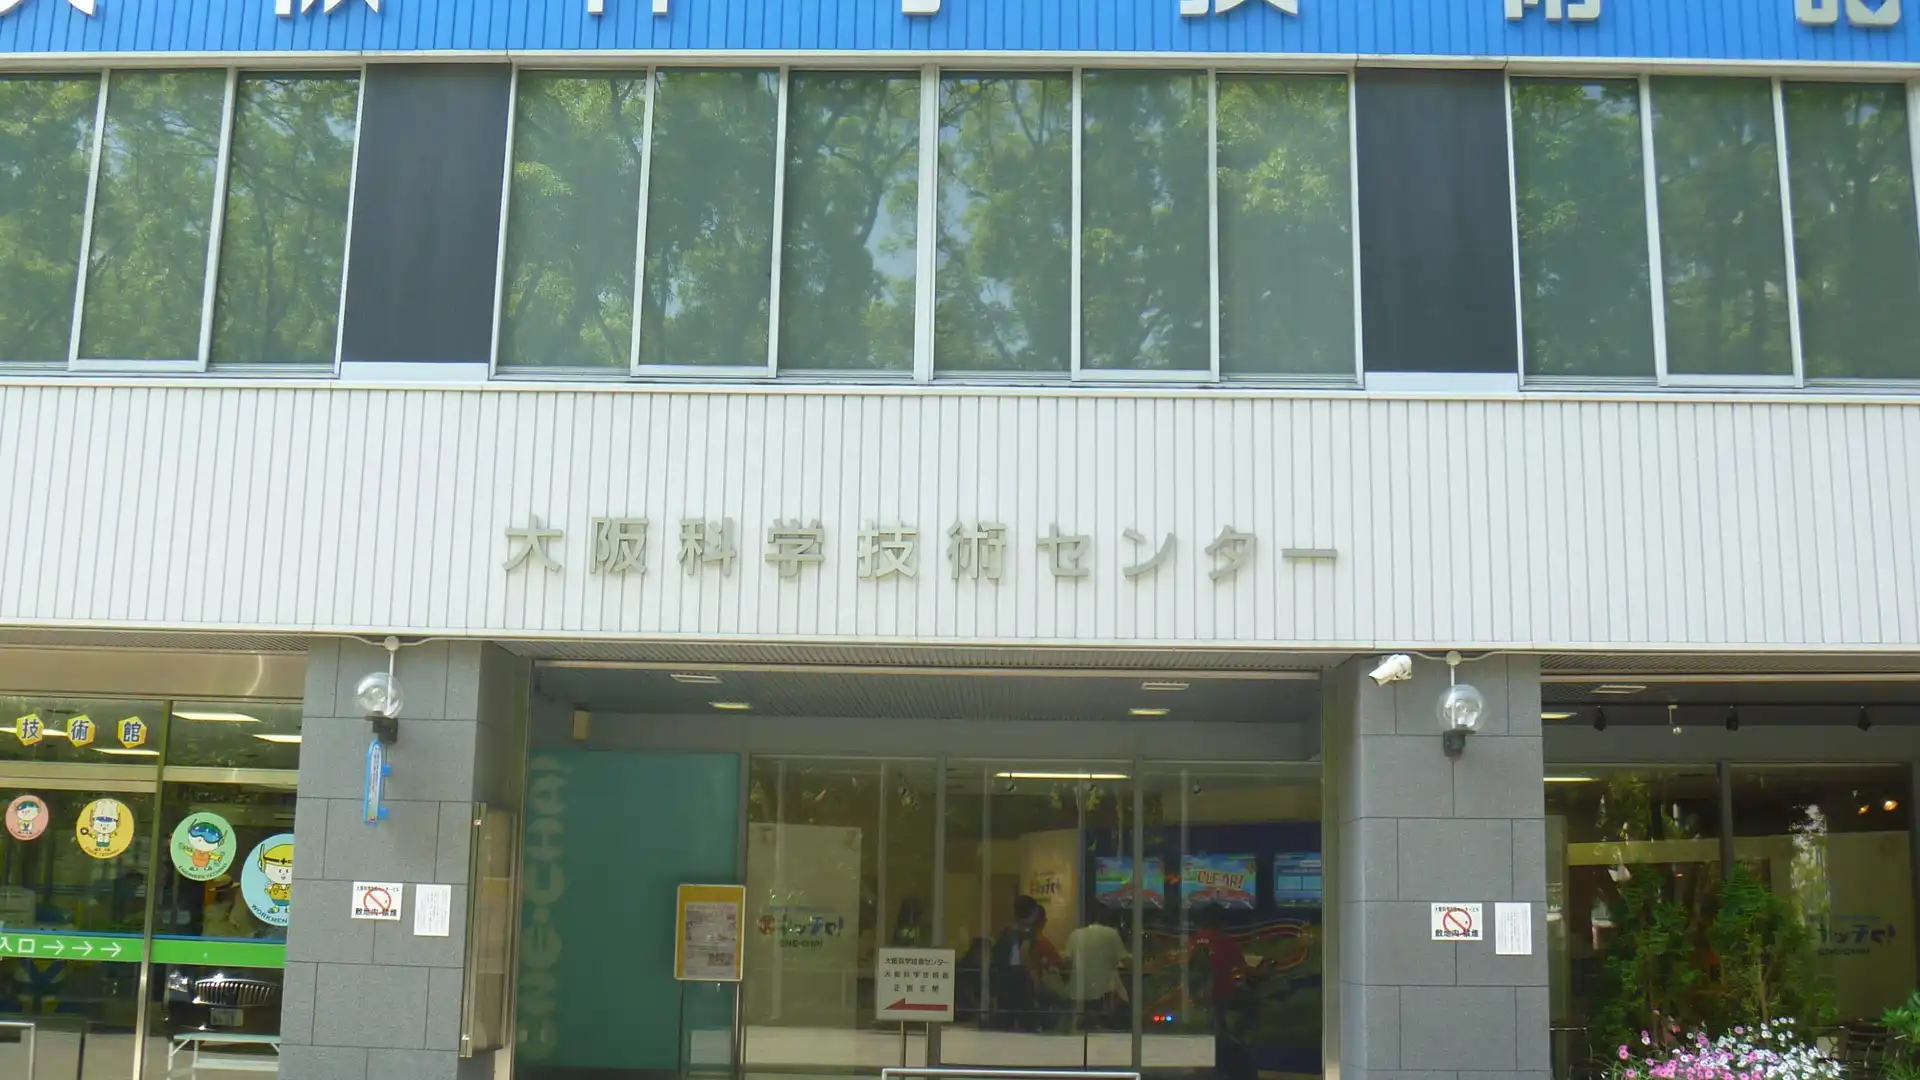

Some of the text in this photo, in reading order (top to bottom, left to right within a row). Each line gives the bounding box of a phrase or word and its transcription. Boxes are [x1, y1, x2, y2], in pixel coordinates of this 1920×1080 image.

[502, 513, 1339, 583] 大阪科学技術センター
[21, 718, 142, 742] 技術館
[251, 903, 288, 924] WORKMEN
